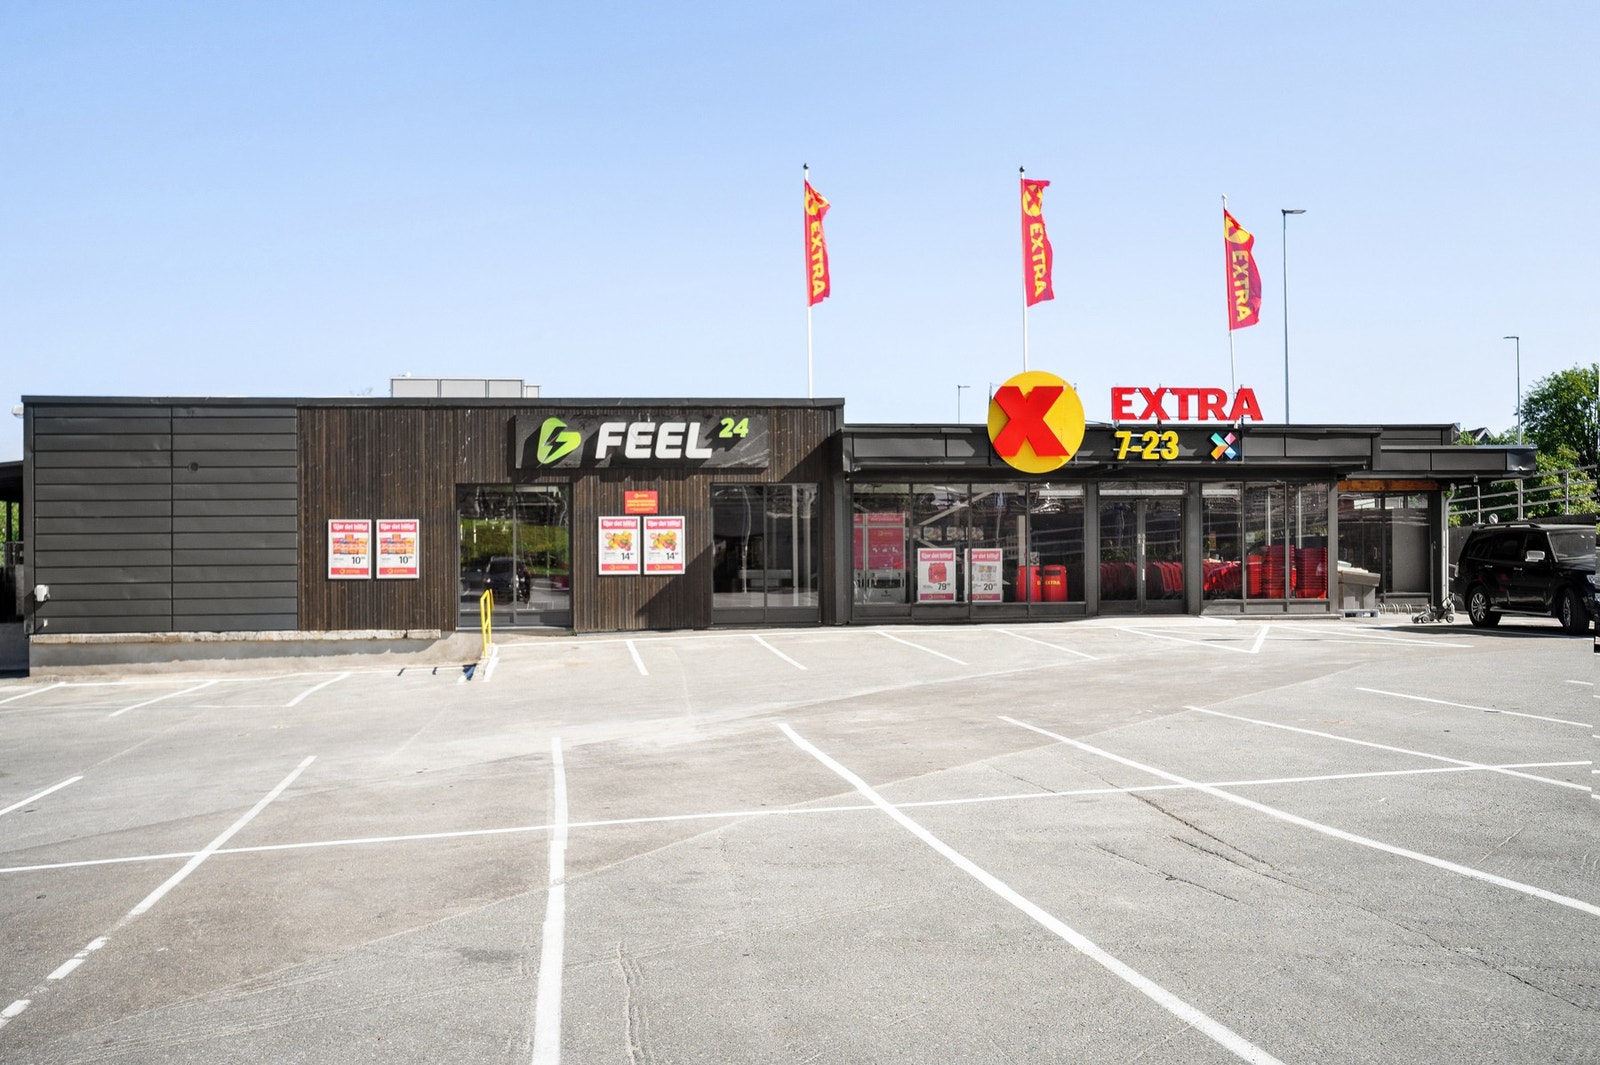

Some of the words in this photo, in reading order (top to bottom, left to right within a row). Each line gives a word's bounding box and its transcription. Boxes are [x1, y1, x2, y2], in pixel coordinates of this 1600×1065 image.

[811, 221, 826, 297] EXTRA
[1029, 223, 1047, 297] EXTRA
[1232, 250, 1252, 322] EXTRA
[1111, 387, 1264, 421] EXTRA
[595, 422, 713, 459] FEEL
[718, 417, 749, 439] 24
[1114, 430, 1179, 460] 7-23
